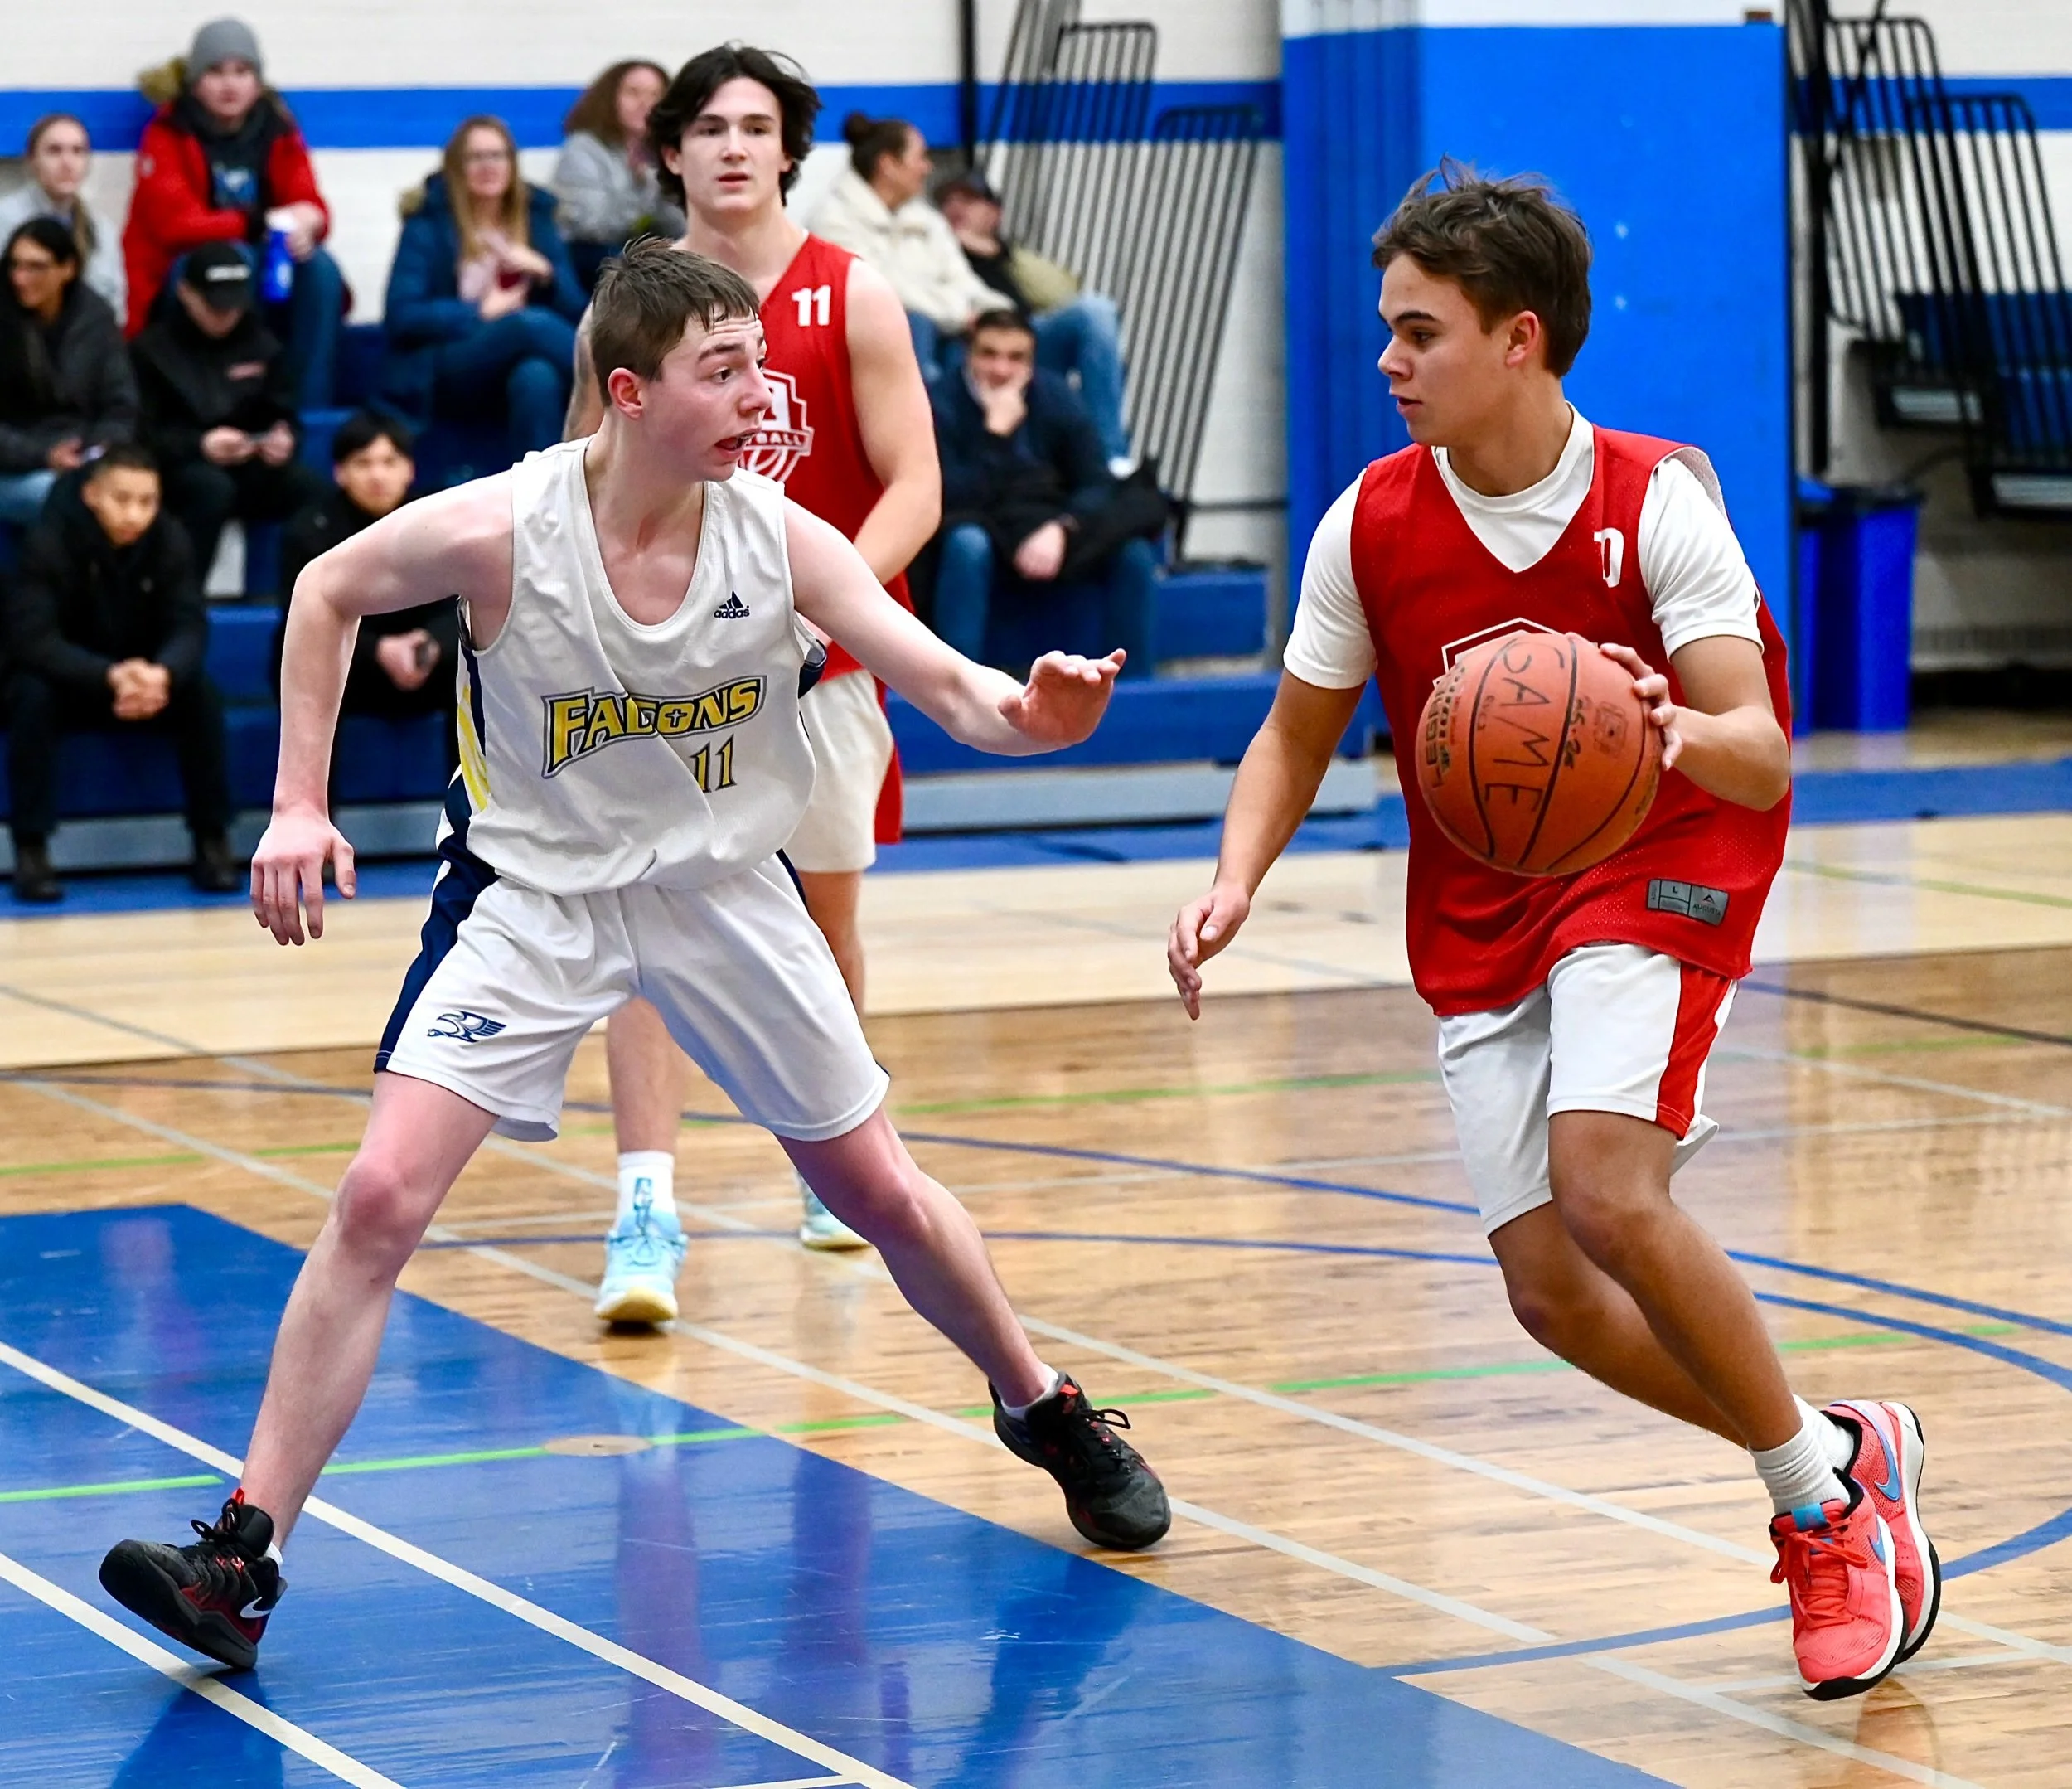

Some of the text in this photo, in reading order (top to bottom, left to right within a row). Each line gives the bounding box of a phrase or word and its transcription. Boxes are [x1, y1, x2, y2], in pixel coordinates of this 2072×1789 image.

[792, 284, 831, 327] 11
[1593, 527, 1624, 588] 0
[714, 607, 750, 619] addas
[689, 733, 737, 793] 11
